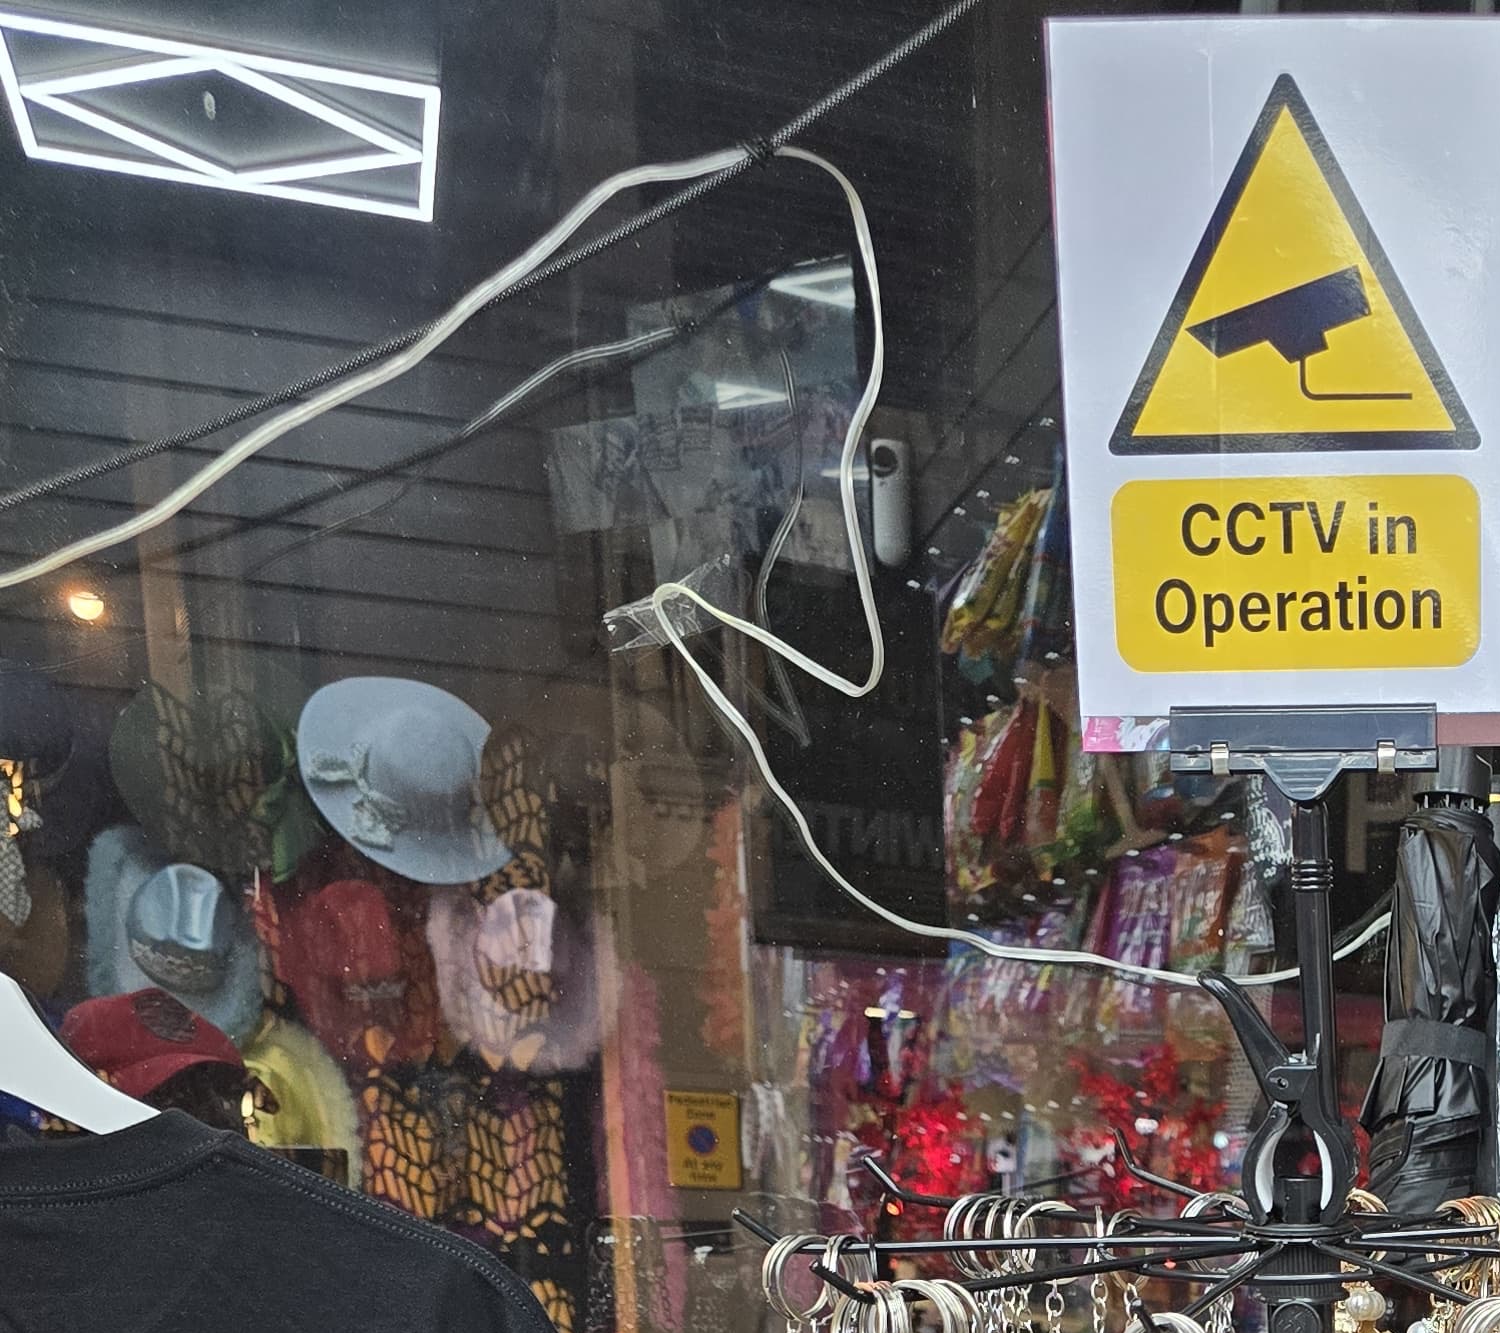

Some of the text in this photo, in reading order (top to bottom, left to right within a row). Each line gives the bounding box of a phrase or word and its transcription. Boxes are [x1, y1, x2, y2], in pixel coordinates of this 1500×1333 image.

[1180, 501, 1419, 556] CCTV in
[1154, 576, 1443, 648] Operation
